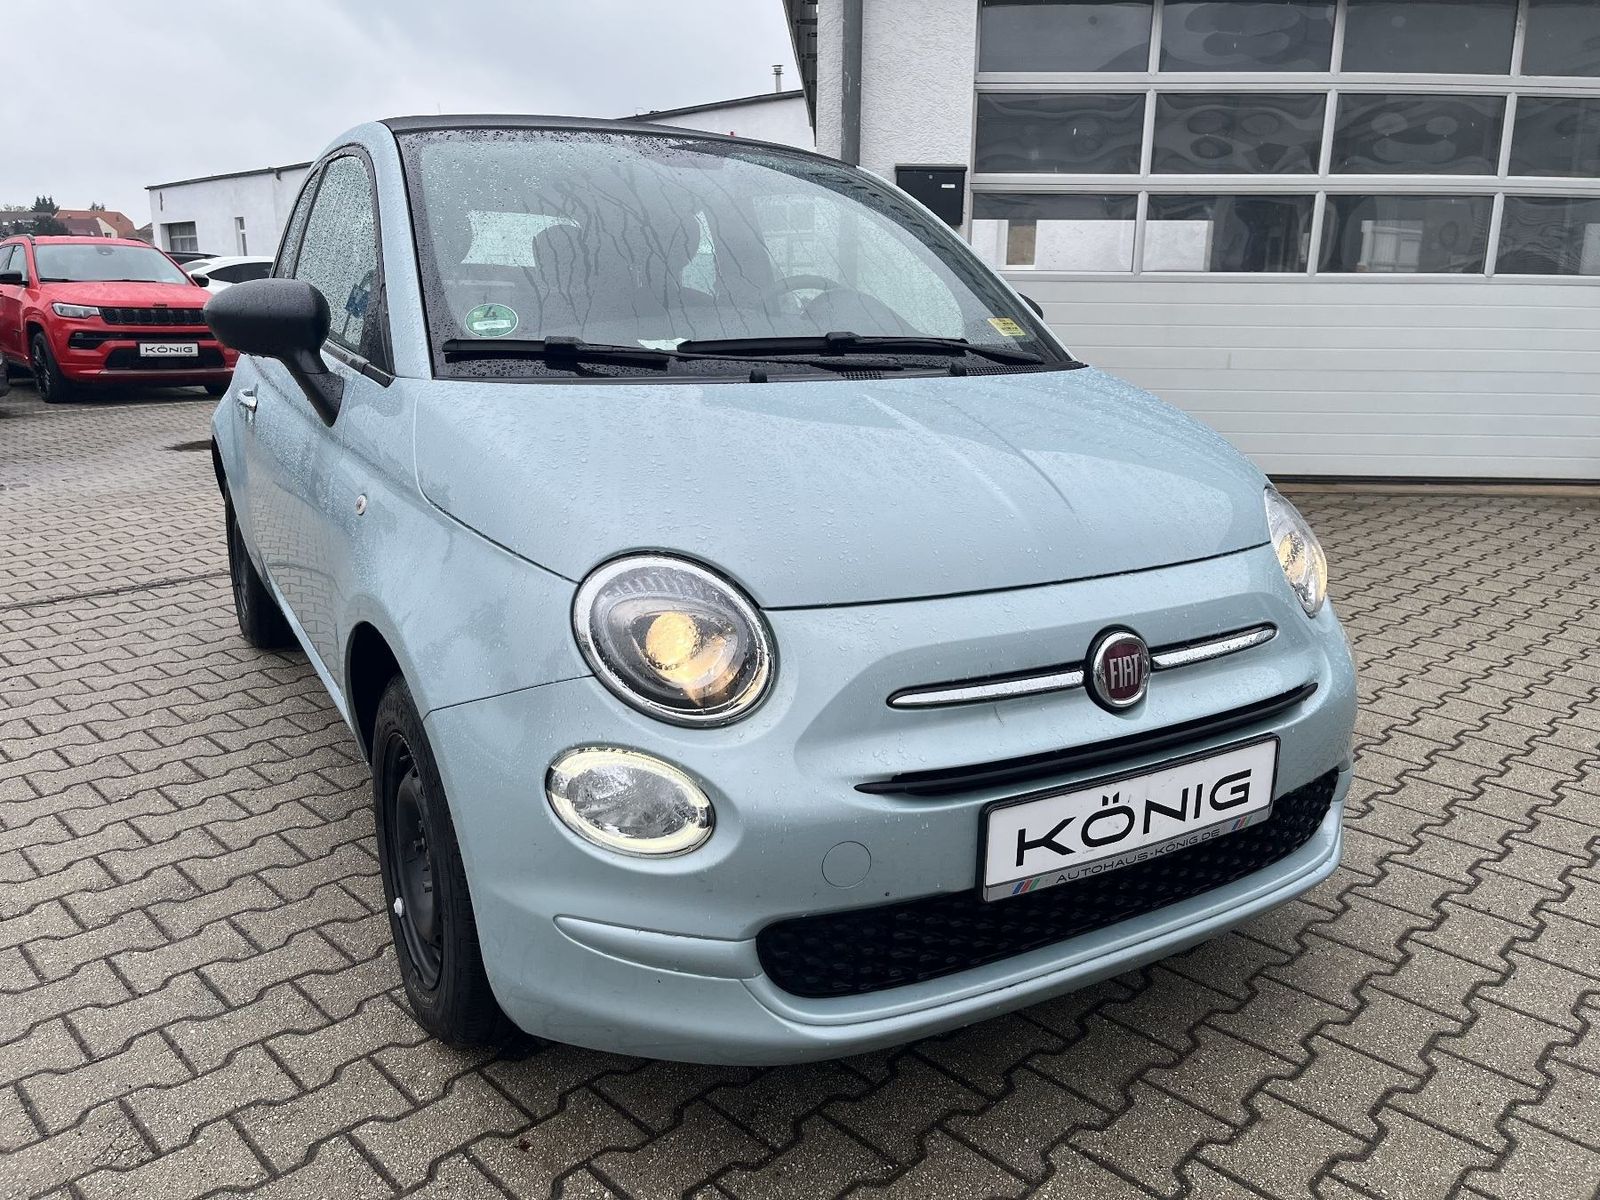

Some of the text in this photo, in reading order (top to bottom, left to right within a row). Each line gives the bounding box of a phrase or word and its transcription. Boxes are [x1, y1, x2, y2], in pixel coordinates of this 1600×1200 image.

[145, 344, 193, 354] KÖNIG
[1109, 653, 1140, 690] FIAT
[1015, 768, 1252, 867] KÖNIG
